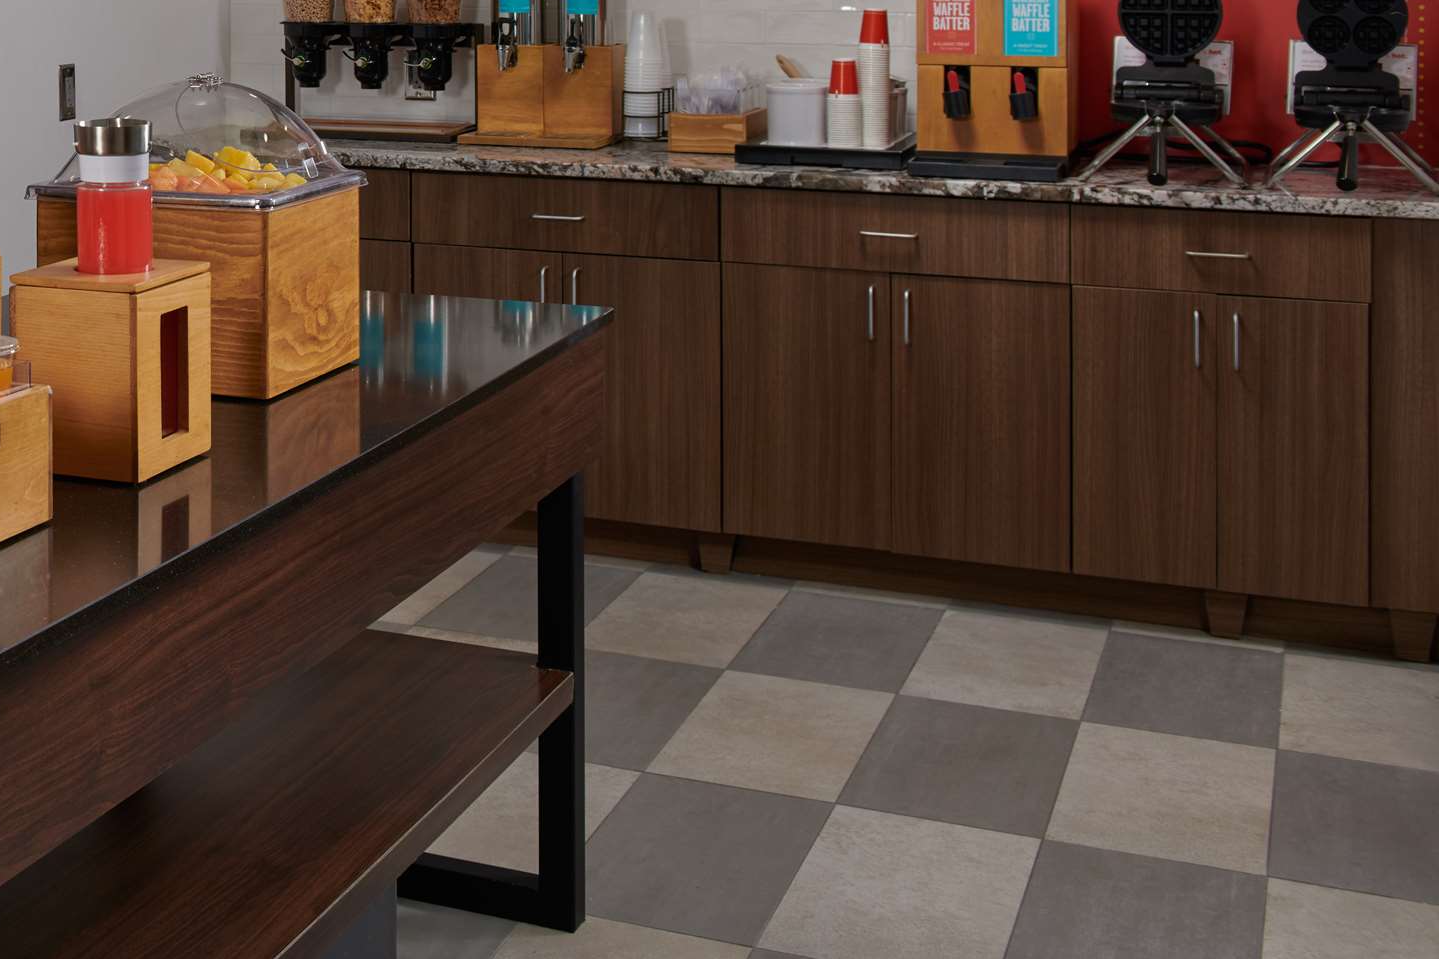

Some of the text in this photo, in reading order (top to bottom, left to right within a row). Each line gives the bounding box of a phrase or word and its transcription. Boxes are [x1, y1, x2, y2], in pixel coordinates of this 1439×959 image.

[933, 2, 970, 17] WAFFLE
[1012, 3, 1050, 18] WAFFLE
[933, 16, 970, 31] BATTER
[1012, 18, 1050, 32] BATTER
